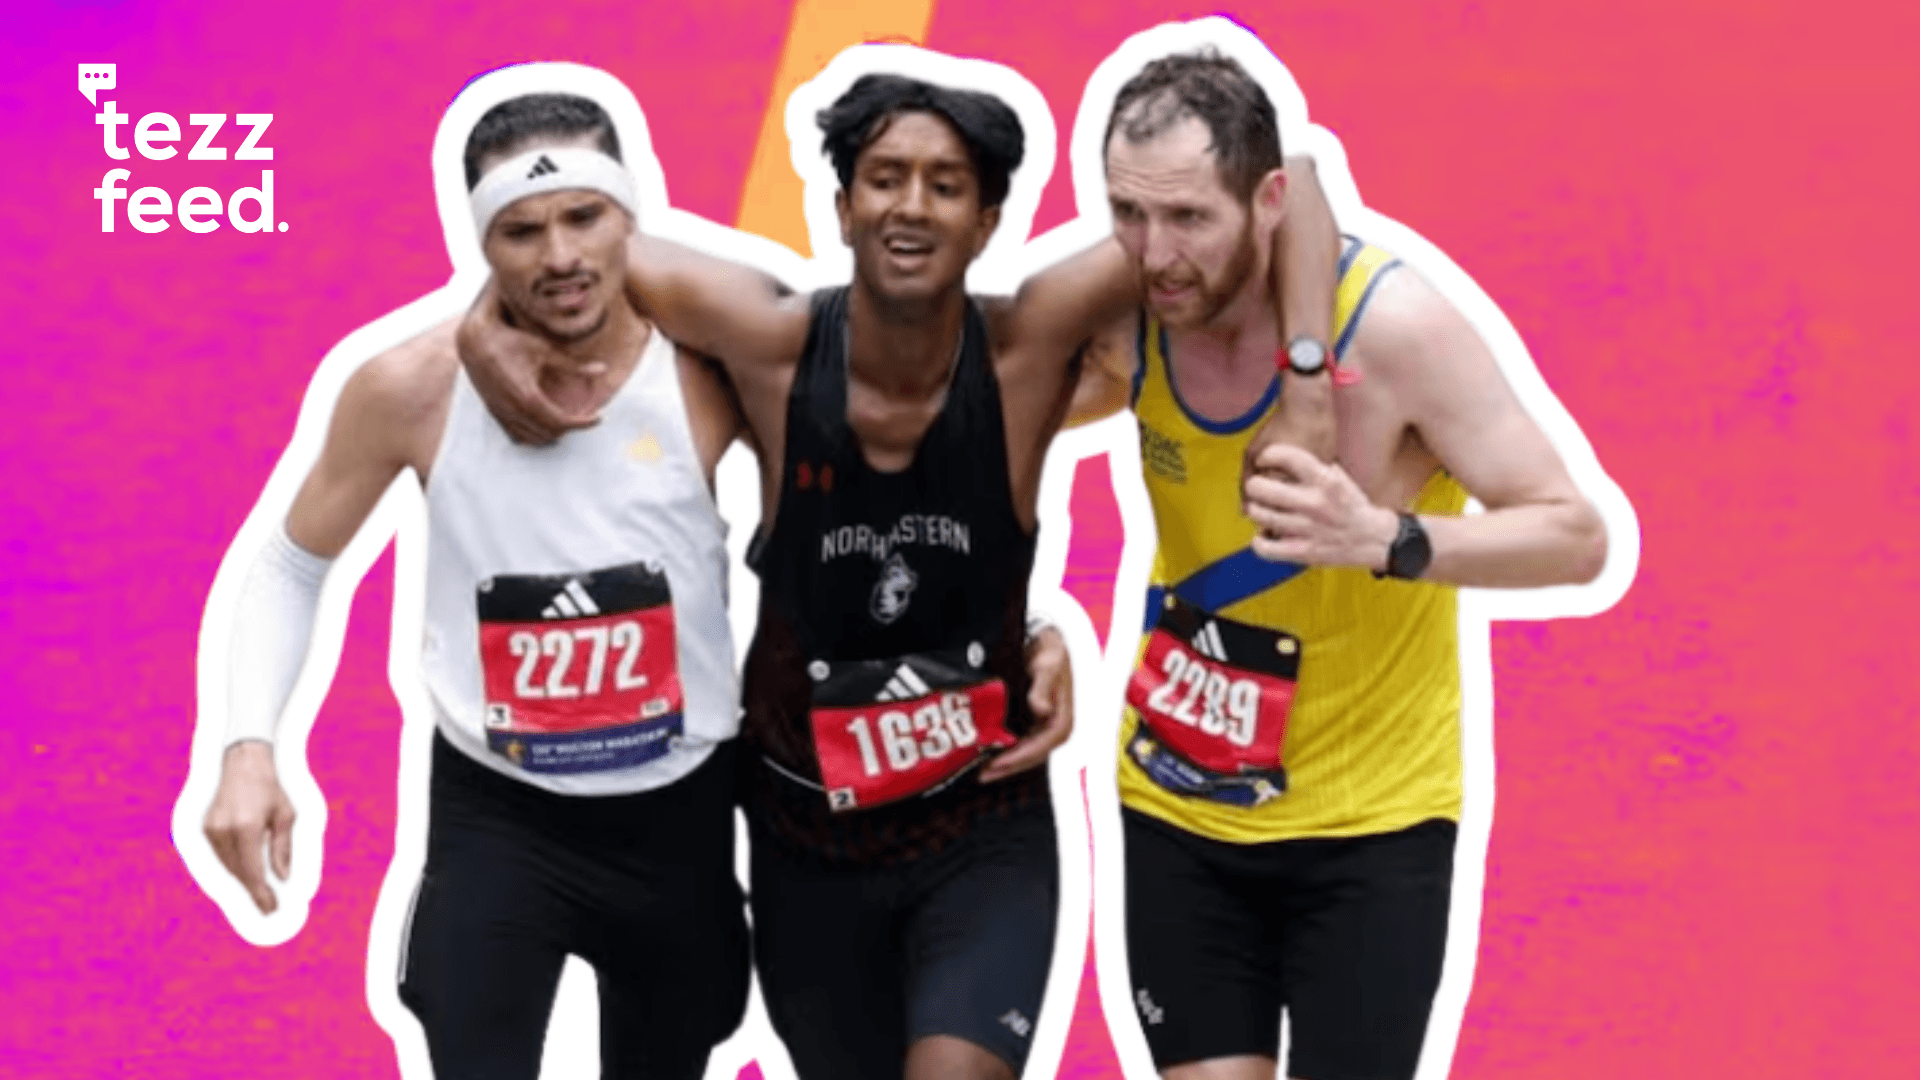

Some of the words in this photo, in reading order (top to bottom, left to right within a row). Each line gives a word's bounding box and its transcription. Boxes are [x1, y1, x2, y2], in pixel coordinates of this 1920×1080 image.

[509, 620, 648, 699] 2272
[1147, 649, 1261, 747] 2289
[846, 692, 978, 778] 1636
